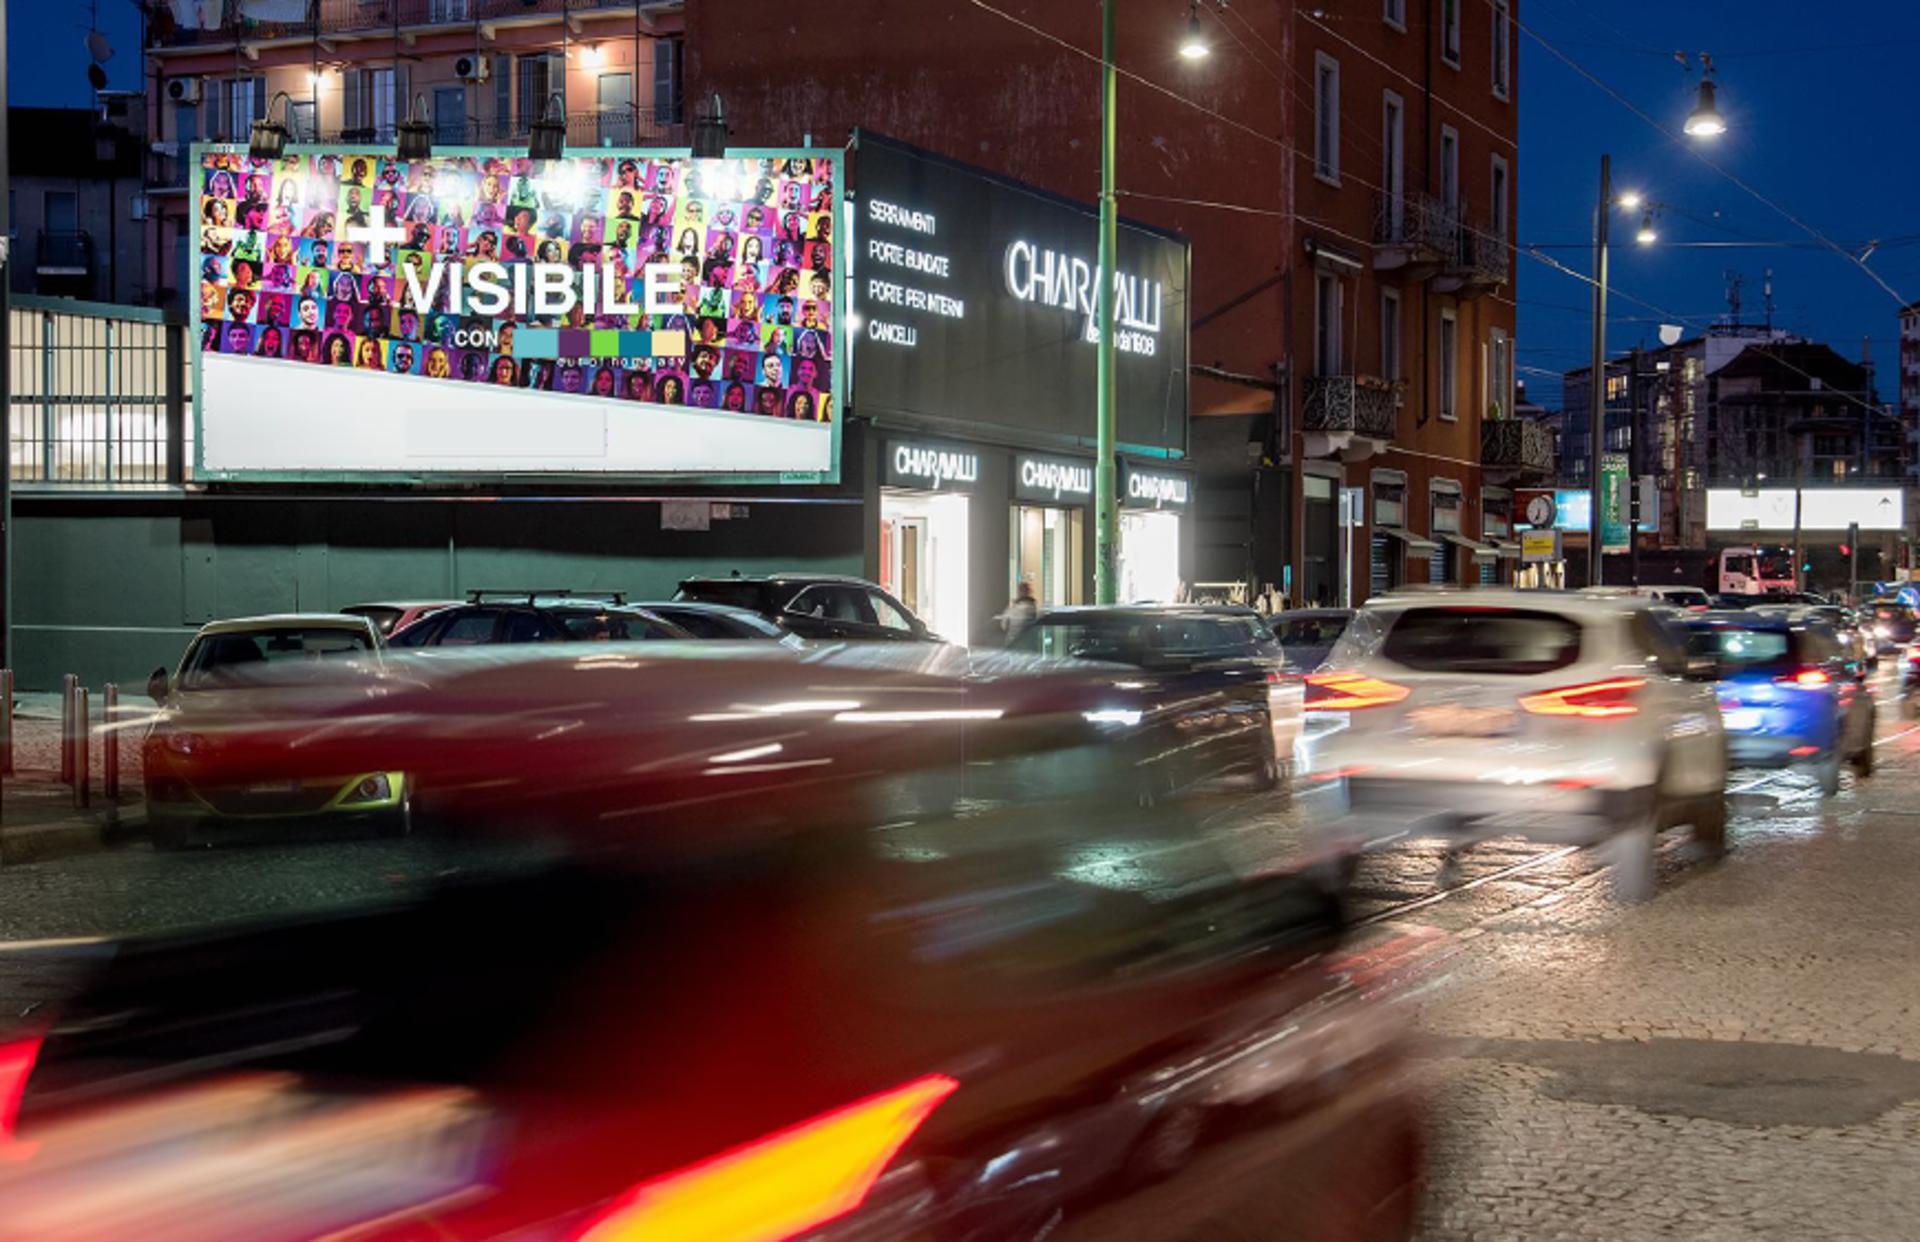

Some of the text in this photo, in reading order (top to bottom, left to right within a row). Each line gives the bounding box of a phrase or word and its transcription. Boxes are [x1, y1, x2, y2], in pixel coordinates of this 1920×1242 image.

[869, 199, 936, 235] SERRAMENTI
[869, 239, 950, 278] PORTE BLINDATE
[401, 261, 685, 316] VISIBILE
[869, 278, 964, 319] PORTE PER INTERNI
[1003, 239, 1162, 332] CHIARALLI
[453, 330, 499, 348] CON
[869, 319, 917, 347] CANCELLI
[895, 446, 978, 490] CHIARAVALLI
[1022, 460, 1092, 500] CHIARAVALLI
[1129, 473, 1188, 509] CHIARAVALLI
